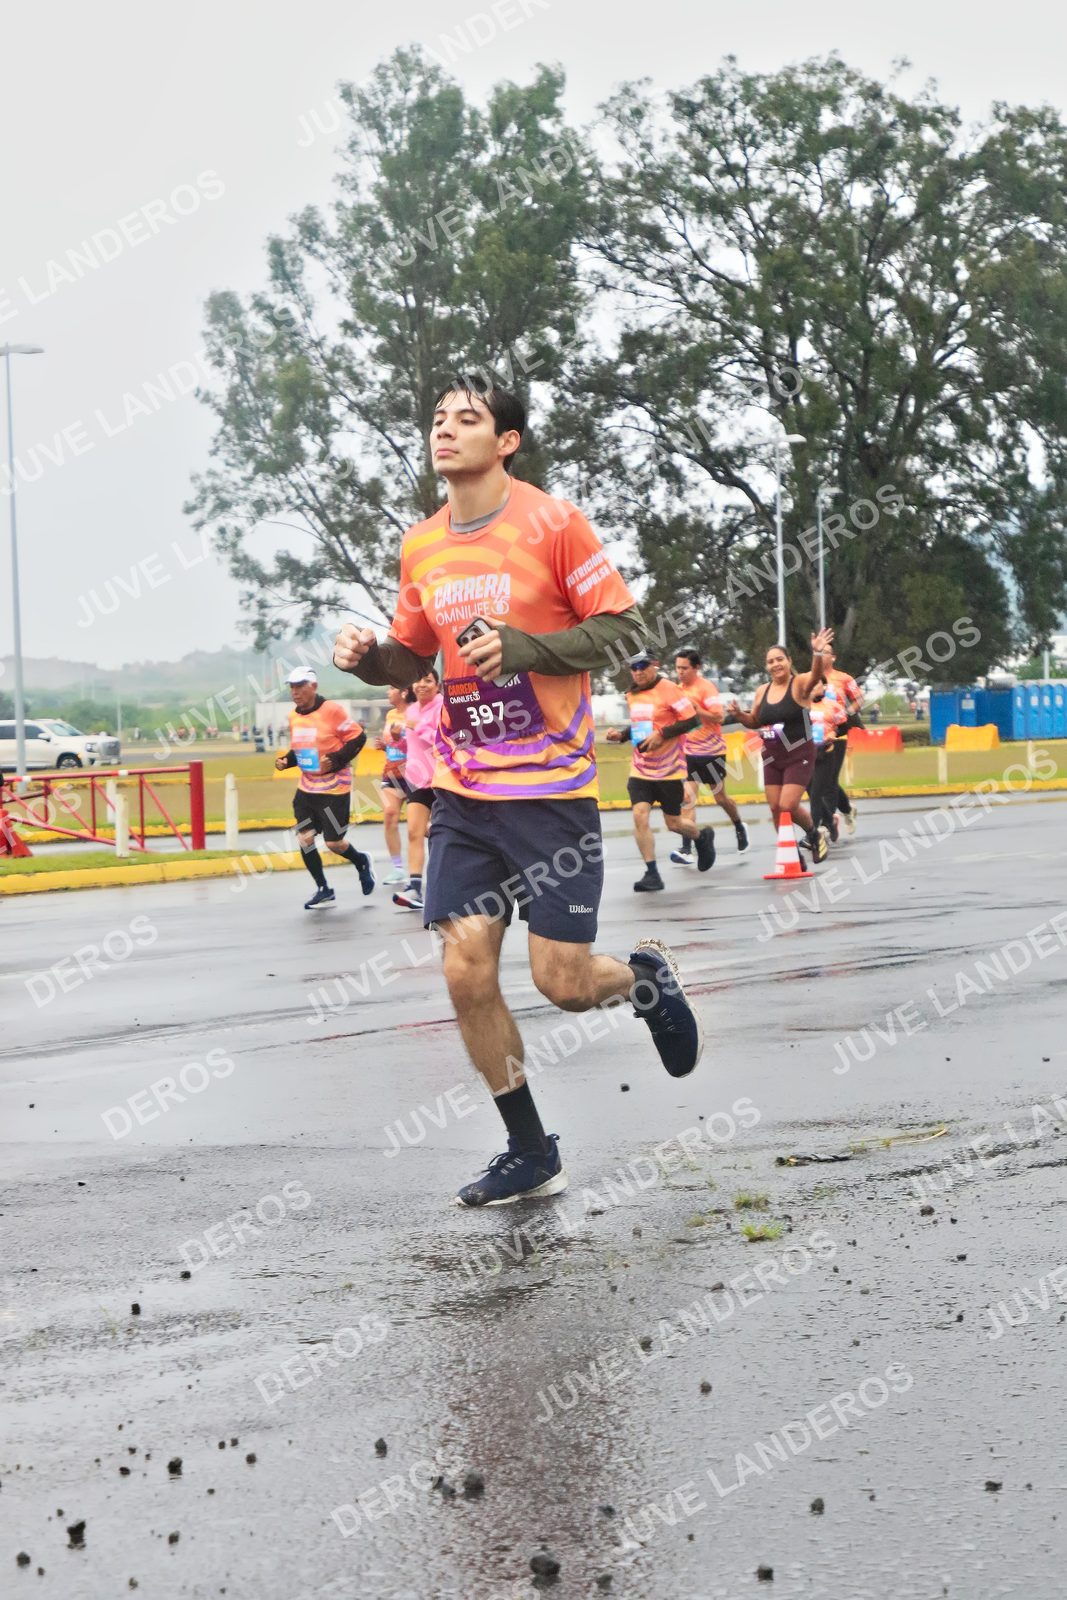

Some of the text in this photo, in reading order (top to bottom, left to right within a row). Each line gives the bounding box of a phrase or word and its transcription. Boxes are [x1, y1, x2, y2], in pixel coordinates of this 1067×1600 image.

[434, 573, 511, 610] CARRERA
[435, 602, 491, 626] OMNILIFE
[447, 681, 479, 697] CARRERA
[449, 693, 473, 705] OMNILIFE
[466, 701, 504, 727] 397
[569, 904, 594, 914] Wilson
